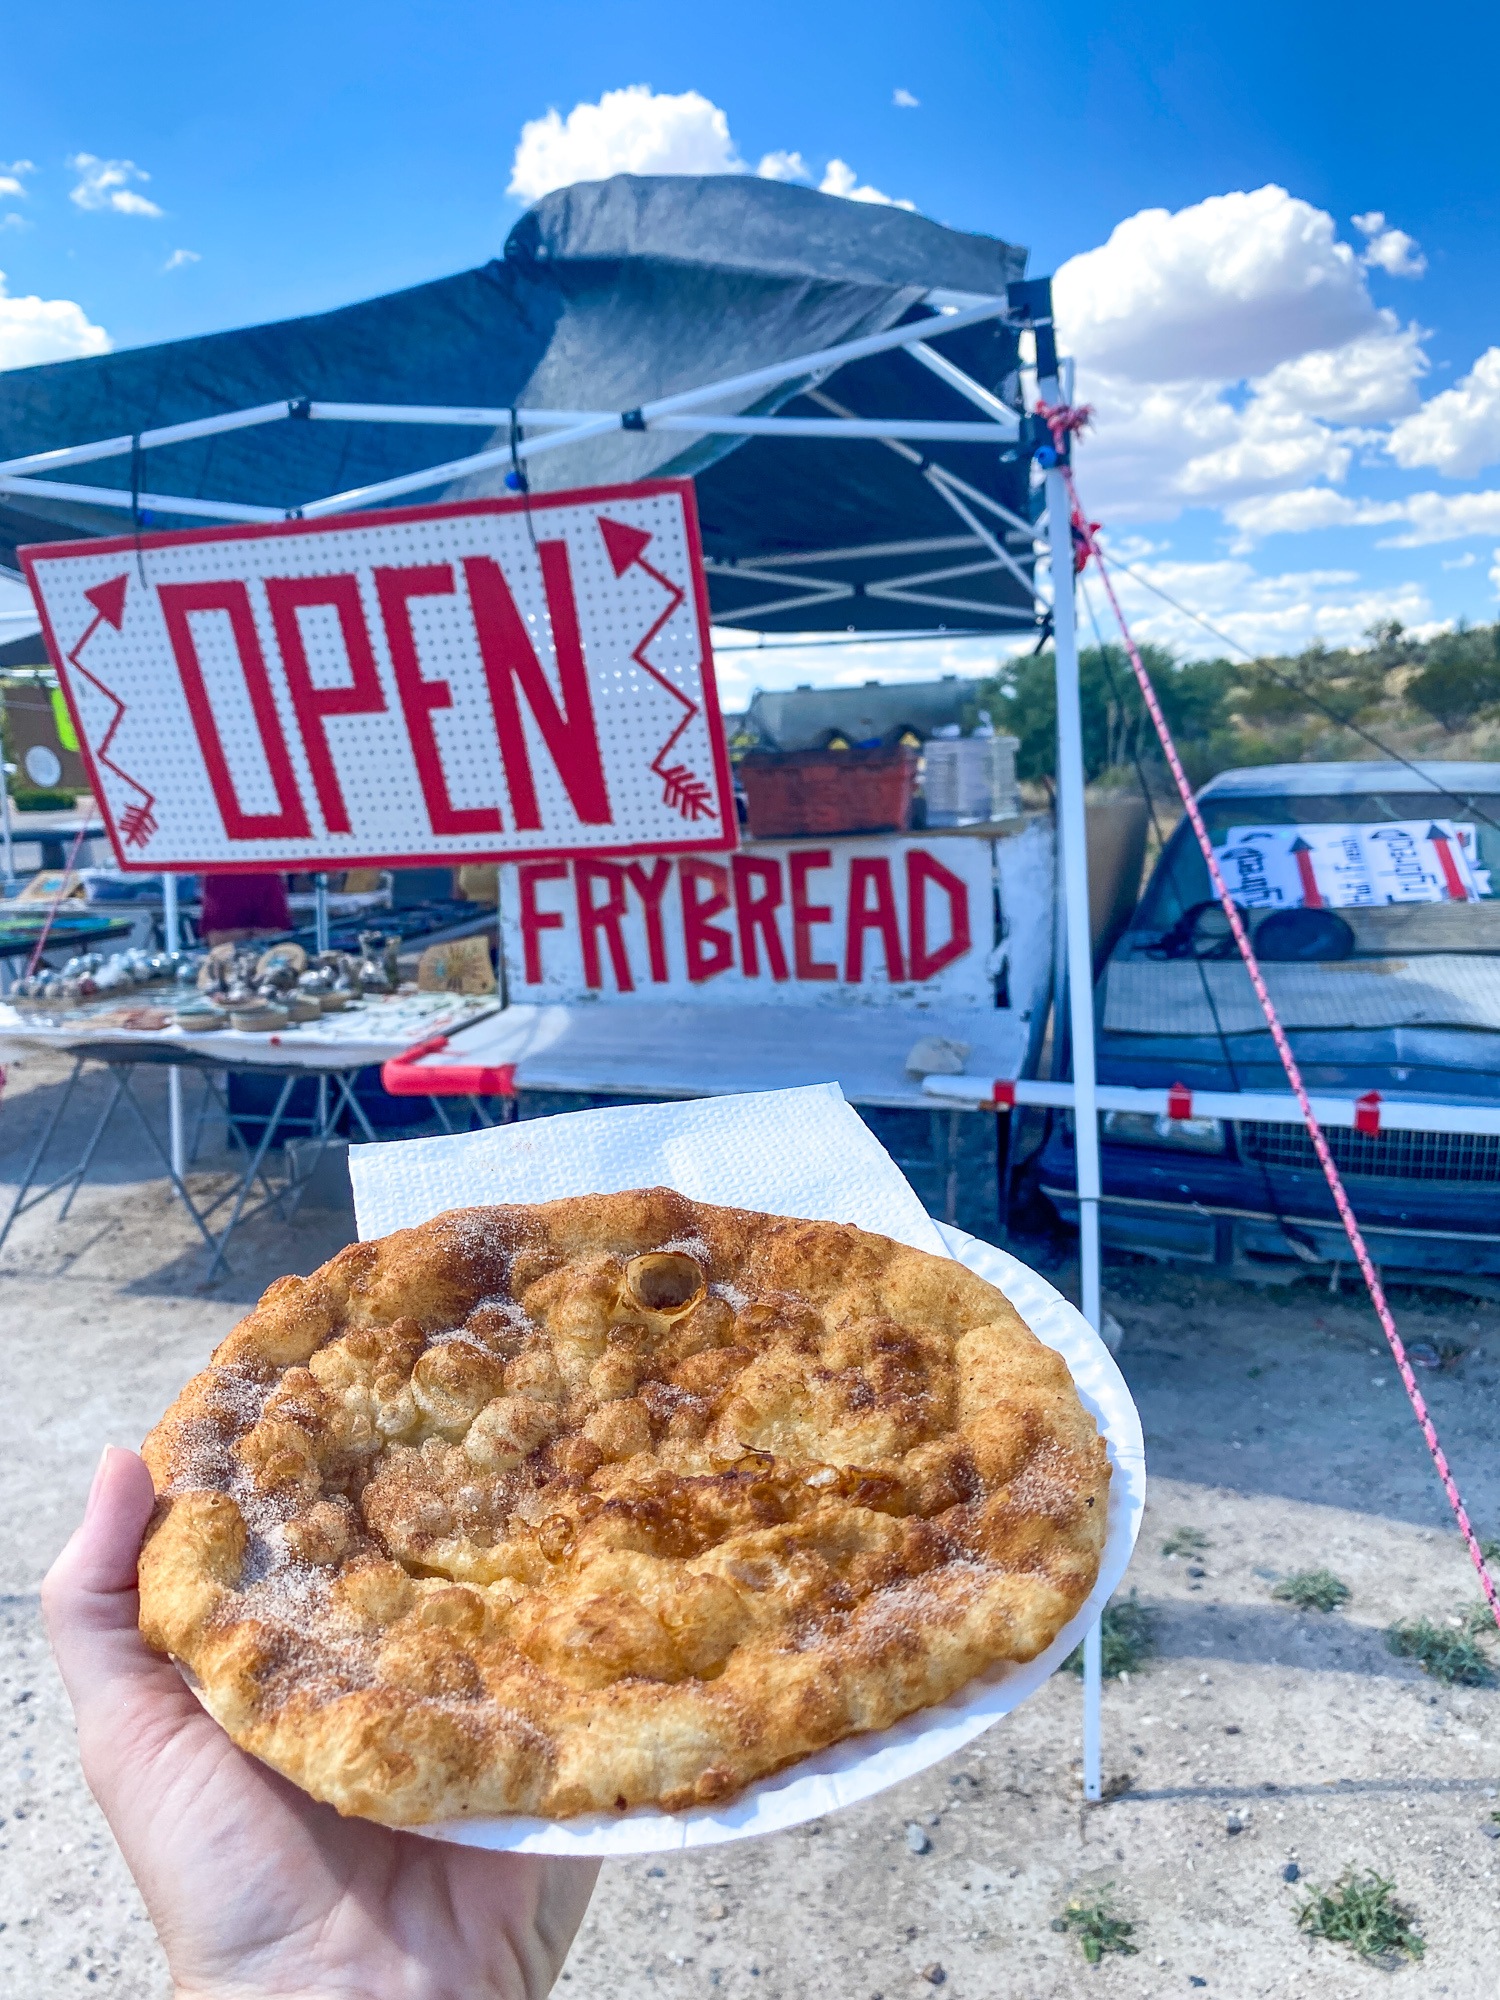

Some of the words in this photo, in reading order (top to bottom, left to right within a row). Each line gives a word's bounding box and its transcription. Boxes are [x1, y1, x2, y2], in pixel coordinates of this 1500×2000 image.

[157, 540, 613, 840] OPEN
[1220, 847, 1283, 908] rybread
[1370, 829, 1437, 903] rybread
[518, 849, 971, 992] FRYBREAD
